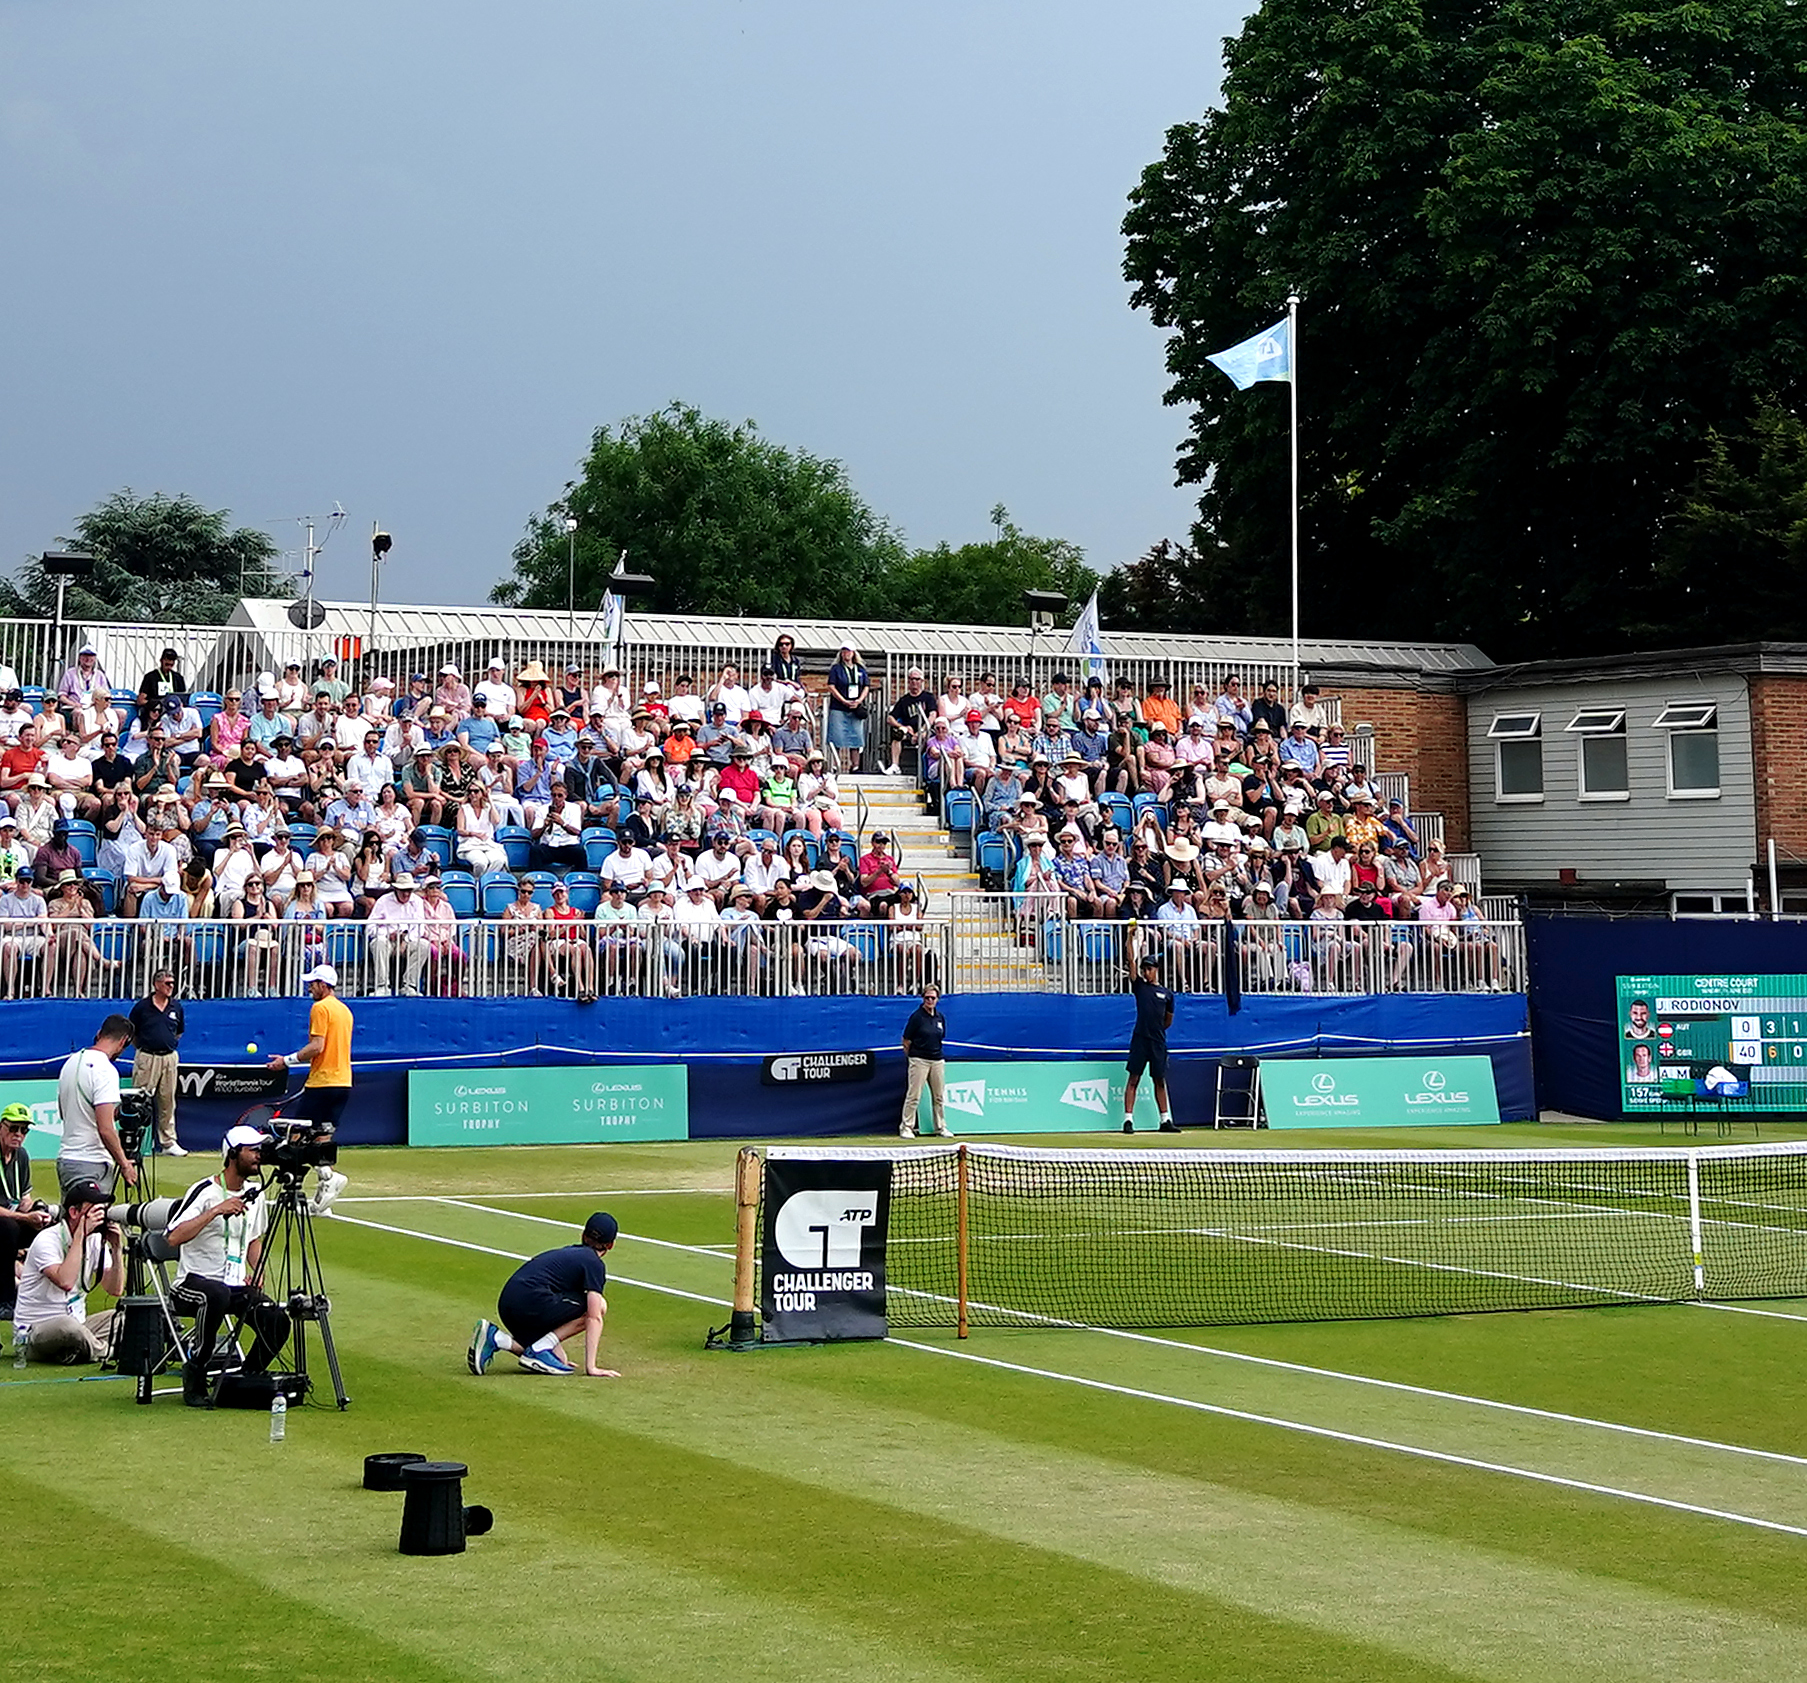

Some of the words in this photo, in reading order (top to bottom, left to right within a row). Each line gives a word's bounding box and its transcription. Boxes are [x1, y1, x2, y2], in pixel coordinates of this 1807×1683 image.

[1730, 977, 1759, 988] COURT
[1671, 1000, 1740, 1011] RODIONOV
[1742, 1020, 1751, 1033] 0
[1766, 1021, 1776, 1033] 3
[1793, 1021, 1800, 1033] 1
[1739, 1045, 1756, 1058] 40
[1768, 1045, 1778, 1058] 6
[1793, 1045, 1803, 1058] 0
[803, 1054, 867, 1067] CHALLENGER
[803, 1067, 831, 1079] TOUR
[468, 1087, 507, 1095] LEXUS
[605, 1083, 643, 1091] LEXUS
[987, 1087, 1028, 1097] TENNIS
[1630, 1087, 1649, 1097] 157
[947, 1089, 983, 1106] LTA
[1072, 1088, 1107, 1104] LTA
[1293, 1094, 1359, 1106] LEXUS
[1404, 1091, 1470, 1104] LEXUS
[434, 1100, 528, 1115] SURBITON
[572, 1097, 665, 1112] SURBITON
[463, 1119, 501, 1129] TROPHY
[600, 1115, 637, 1126] TROPHY
[840, 1209, 873, 1222] ATP
[773, 1272, 875, 1293] CHALLENGER
[773, 1293, 817, 1312] TOUR
